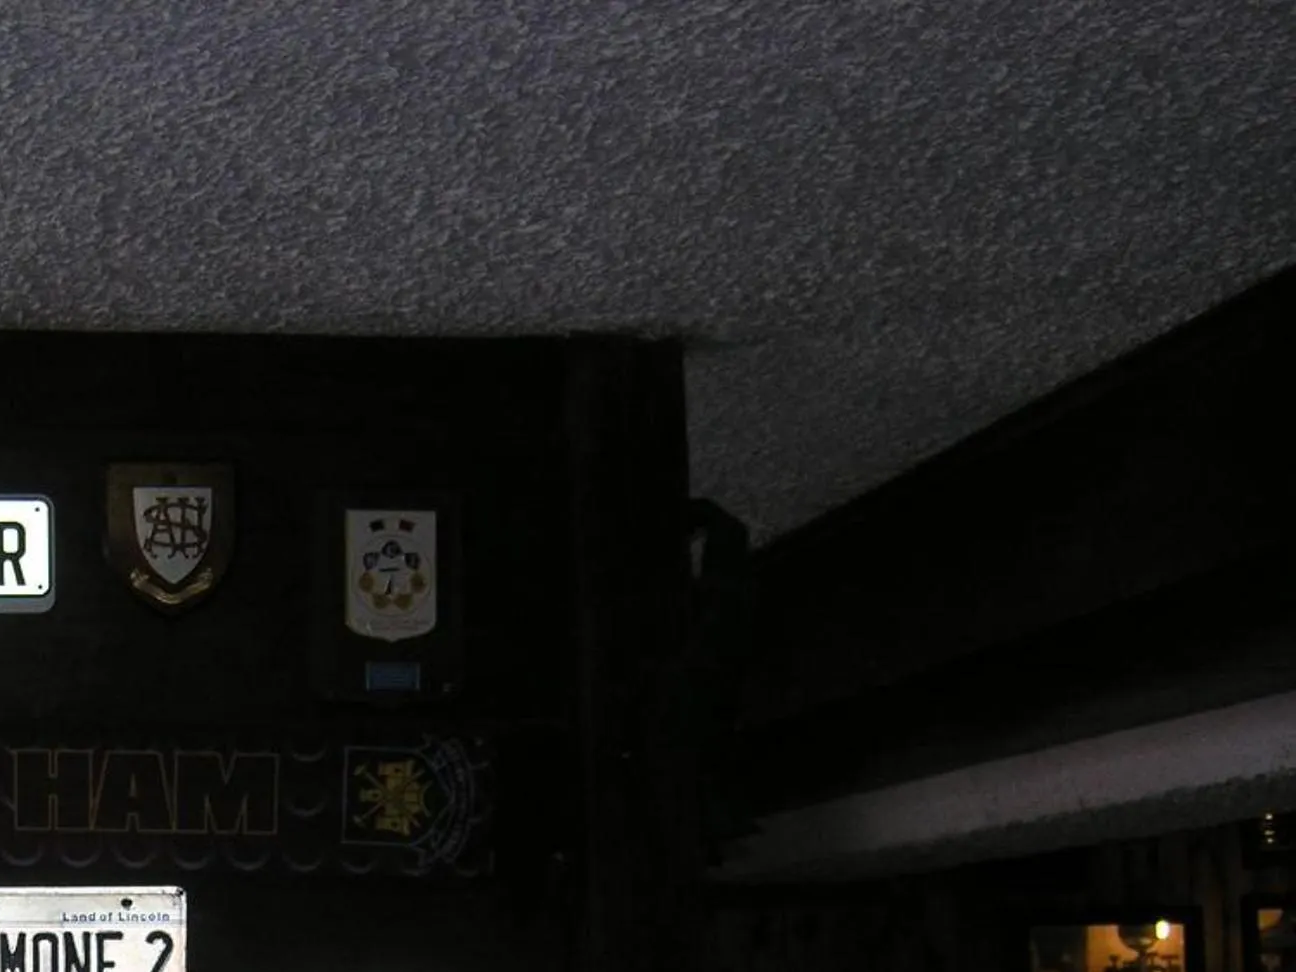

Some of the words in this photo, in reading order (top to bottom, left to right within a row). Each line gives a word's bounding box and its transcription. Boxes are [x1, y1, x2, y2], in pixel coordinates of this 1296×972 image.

[9, 748, 280, 836] HAM
[62, 911, 96, 923] Land
[99, 911, 114, 923] of
[118, 910, 171, 922] Lincoln
